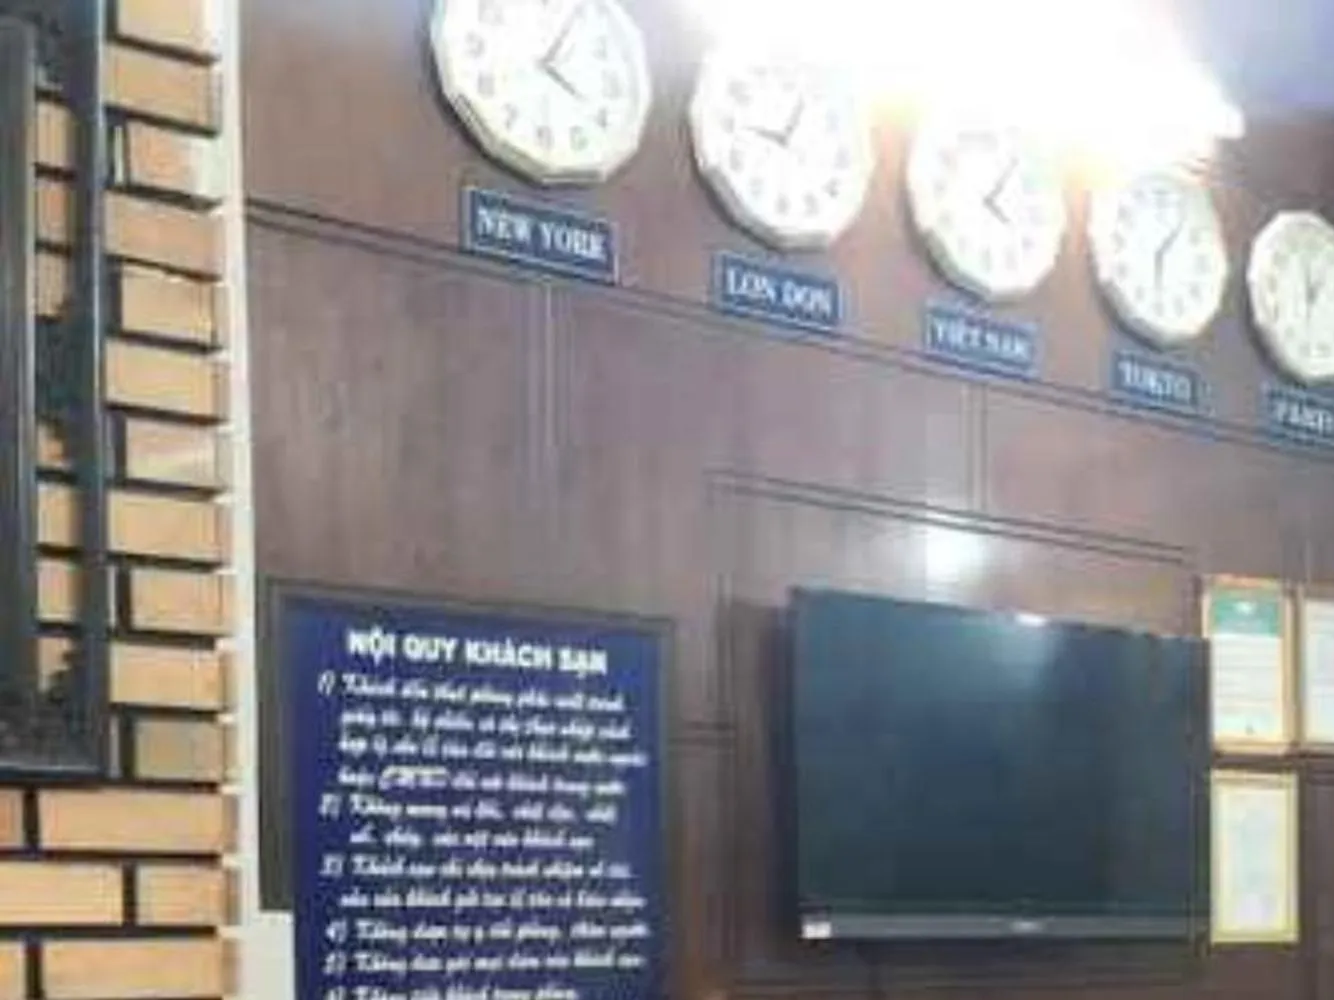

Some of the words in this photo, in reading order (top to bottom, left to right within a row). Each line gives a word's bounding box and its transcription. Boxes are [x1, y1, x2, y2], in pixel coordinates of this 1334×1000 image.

[478, 206, 531, 245] NEW
[540, 222, 608, 262] YORK
[347, 626, 396, 666] NỘI
[402, 633, 458, 662] QUY
